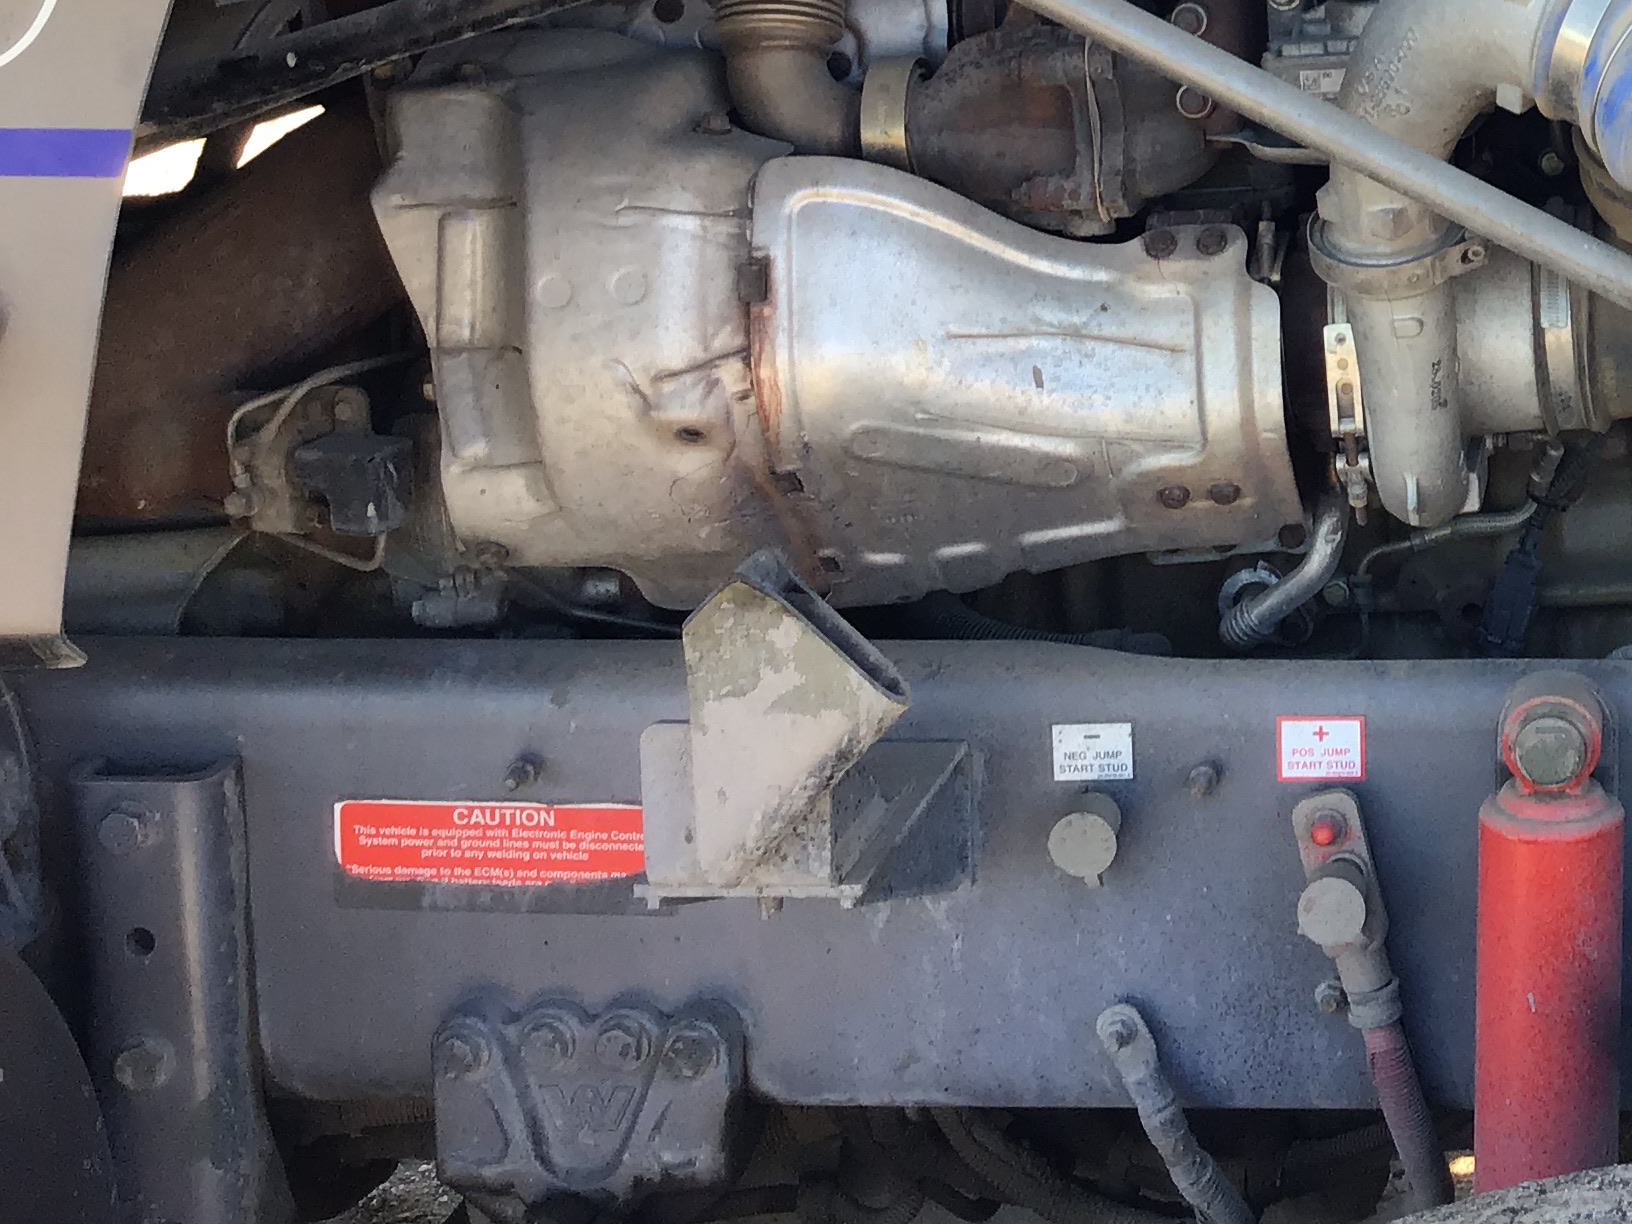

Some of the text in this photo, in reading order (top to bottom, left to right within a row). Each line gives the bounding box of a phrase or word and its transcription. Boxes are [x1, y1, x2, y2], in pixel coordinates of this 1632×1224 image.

[1063, 750, 1123, 761] NEG JUMP
[1292, 747, 1351, 757] POS JUMP
[1059, 763, 1129, 774] START STUD
[1287, 760, 1356, 770] START STUD
[452, 808, 555, 827] CAUTION
[353, 825, 376, 835] This
[379, 826, 417, 836] vehicle
[420, 827, 430, 836] is
[431, 827, 483, 838] equipped
[486, 828, 509, 838] with
[512, 829, 567, 839] Electronic
[570, 830, 609, 841] Engine
[358, 835, 399, 847] System
[401, 837, 435, 847] power
[437, 837, 458, 847] and
[461, 837, 500, 849] ground
[503, 839, 529, 848] lines
[532, 840, 560, 849] must
[562, 840, 576, 850] be
[421, 848, 590, 861] prior to any welding on vehicle
[394, 865, 438, 877] damage
[440, 866, 452, 876] to
[454, 867, 471, 876] the
[474, 867, 514, 878] ECM(s)
[517, 868, 538, 878] and
[540, 869, 609, 881] components
